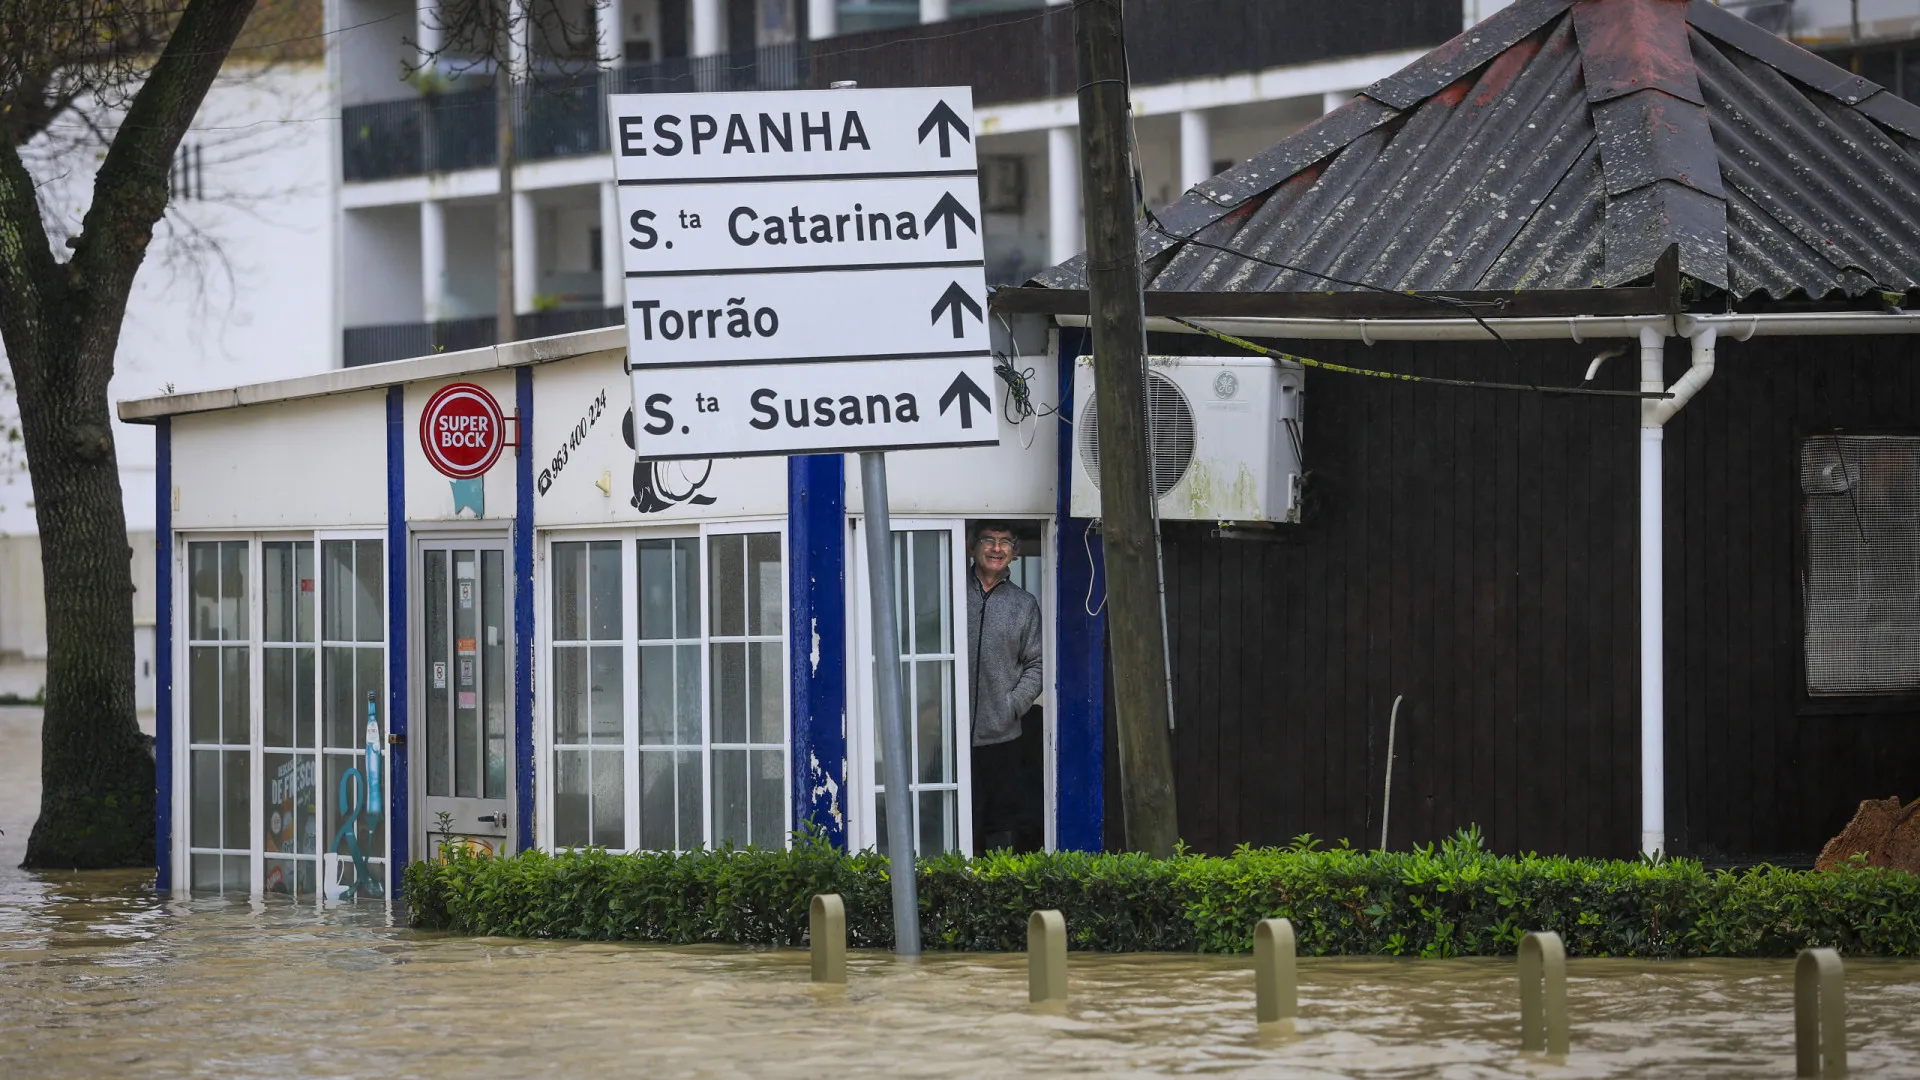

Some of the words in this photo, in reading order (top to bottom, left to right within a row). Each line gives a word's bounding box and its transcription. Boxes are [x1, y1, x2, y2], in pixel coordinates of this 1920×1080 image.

[618, 110, 871, 157] ESPANHA
[629, 209, 702, 250] S.ta
[728, 203, 919, 246] Catarina
[632, 297, 779, 341] Torrão
[439, 415, 488, 431] SUPER
[551, 443, 568, 479] 963
[569, 417, 587, 451] 400
[588, 388, 606, 428] 224
[643, 393, 720, 435] S.ta
[749, 388, 920, 431] Susana
[441, 432, 486, 447] BOCK
[271, 778, 283, 804] DE
